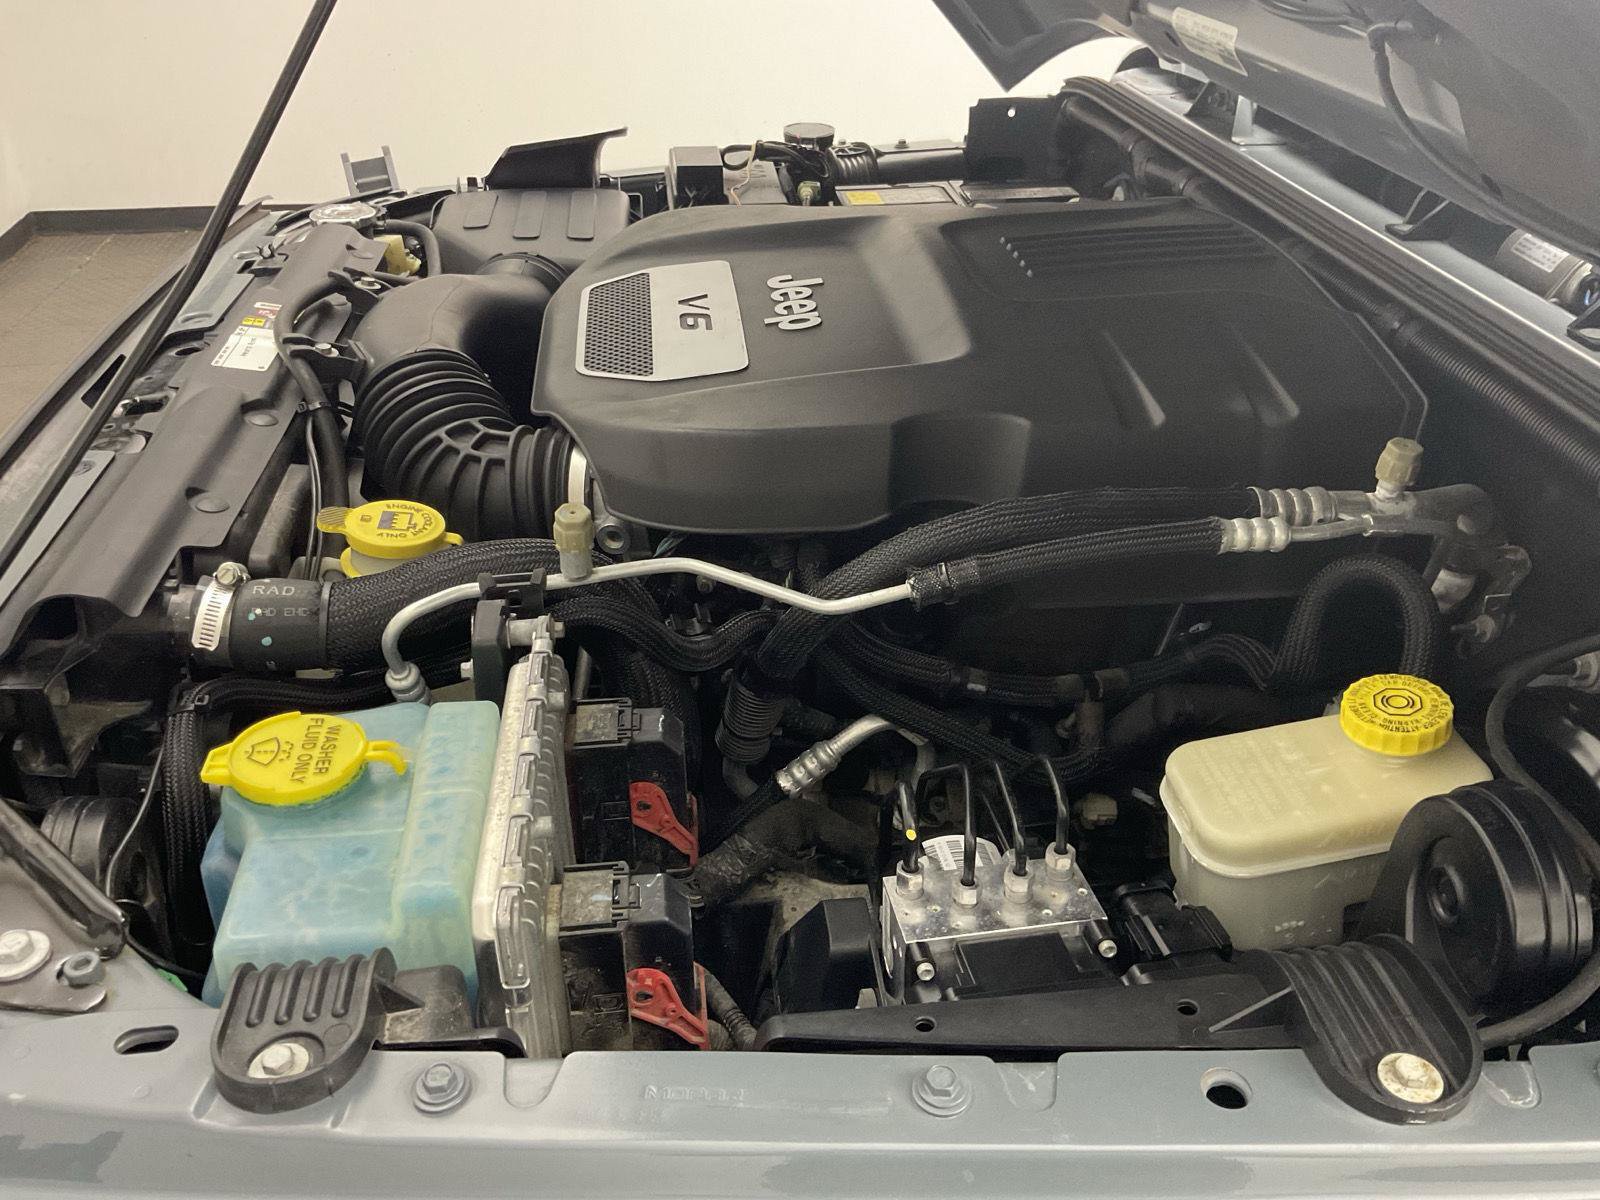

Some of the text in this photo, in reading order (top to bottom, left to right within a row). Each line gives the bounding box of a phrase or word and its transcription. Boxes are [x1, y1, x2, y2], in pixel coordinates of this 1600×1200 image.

[677, 293, 713, 331] V6
[764, 274, 824, 331] Jeep
[252, 585, 295, 596] RAD
[290, 717, 325, 784] FLUID ONLY
[313, 724, 342, 776] WASHER
